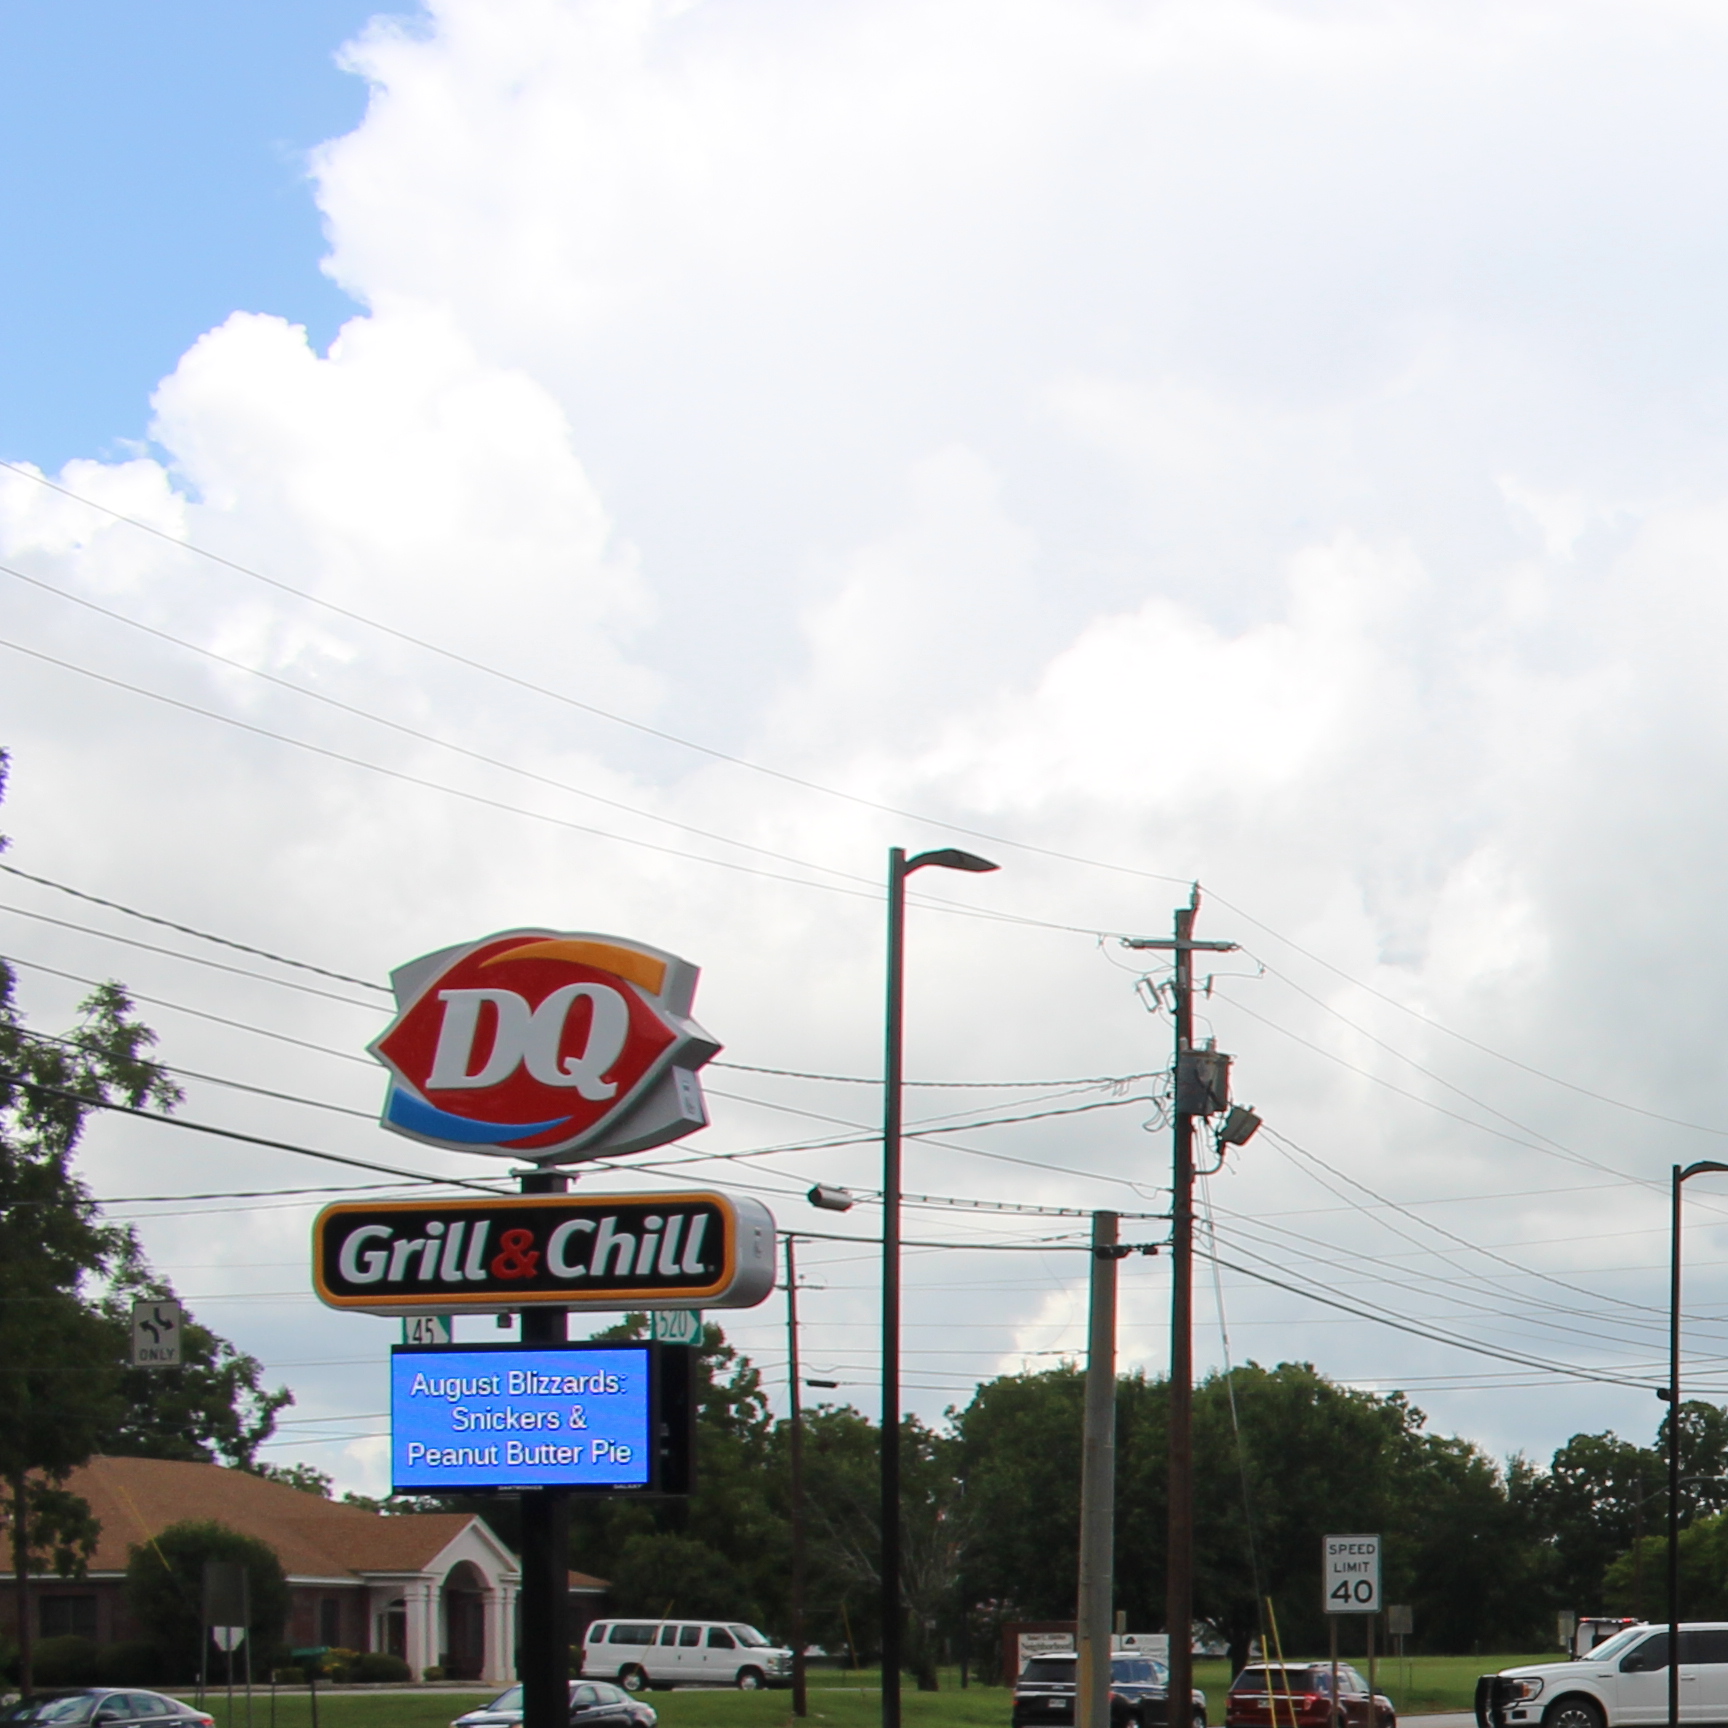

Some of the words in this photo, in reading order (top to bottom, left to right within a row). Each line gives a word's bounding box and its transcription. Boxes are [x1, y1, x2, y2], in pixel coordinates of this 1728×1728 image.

[425, 982, 630, 1101] DQ
[338, 1219, 491, 1284] Grill
[490, 1228, 540, 1280] &
[545, 1213, 710, 1277] Chill
[412, 1317, 435, 1344] 45
[139, 1347, 176, 1361] ONLY
[409, 1372, 501, 1402] August
[507, 1369, 629, 1396] Blizzards:
[451, 1407, 561, 1432] Snickers
[567, 1405, 588, 1430] &
[407, 1442, 499, 1467] Peanut
[505, 1440, 584, 1466] Butter
[590, 1439, 632, 1464] Pie
[1328, 1543, 1376, 1556] SPEED
[1333, 1561, 1370, 1573] LIMIT
[1330, 1579, 1374, 1604] 40
